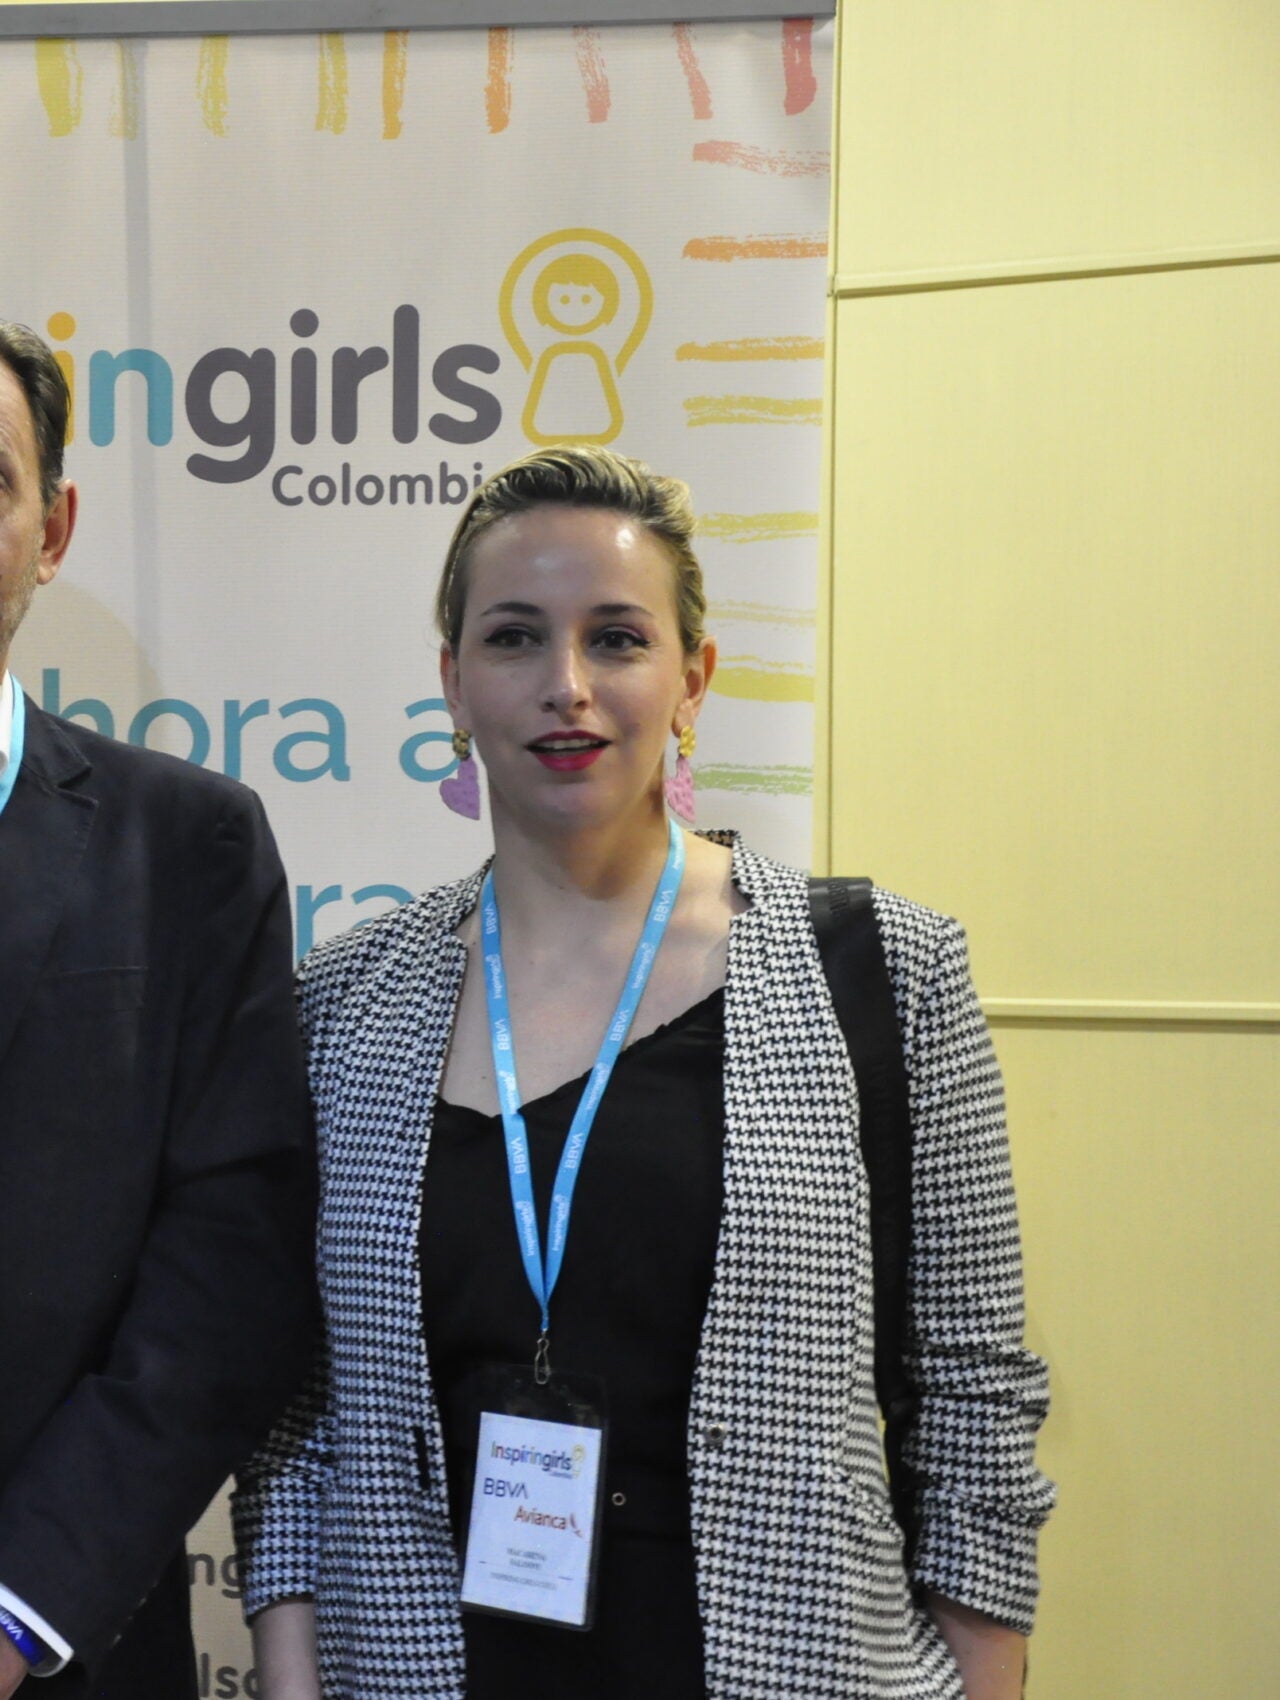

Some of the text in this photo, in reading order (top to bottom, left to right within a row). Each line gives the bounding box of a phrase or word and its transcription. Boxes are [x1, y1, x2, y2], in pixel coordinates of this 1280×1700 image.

[272, 461, 484, 507] Colombi
[511, 1137, 527, 1174] BBVA
[565, 1132, 584, 1169] BBVA
[491, 1440, 571, 1472] Inspiringirls
[483, 1477, 529, 1500] BBVA
[514, 1505, 567, 1531] Avianca
